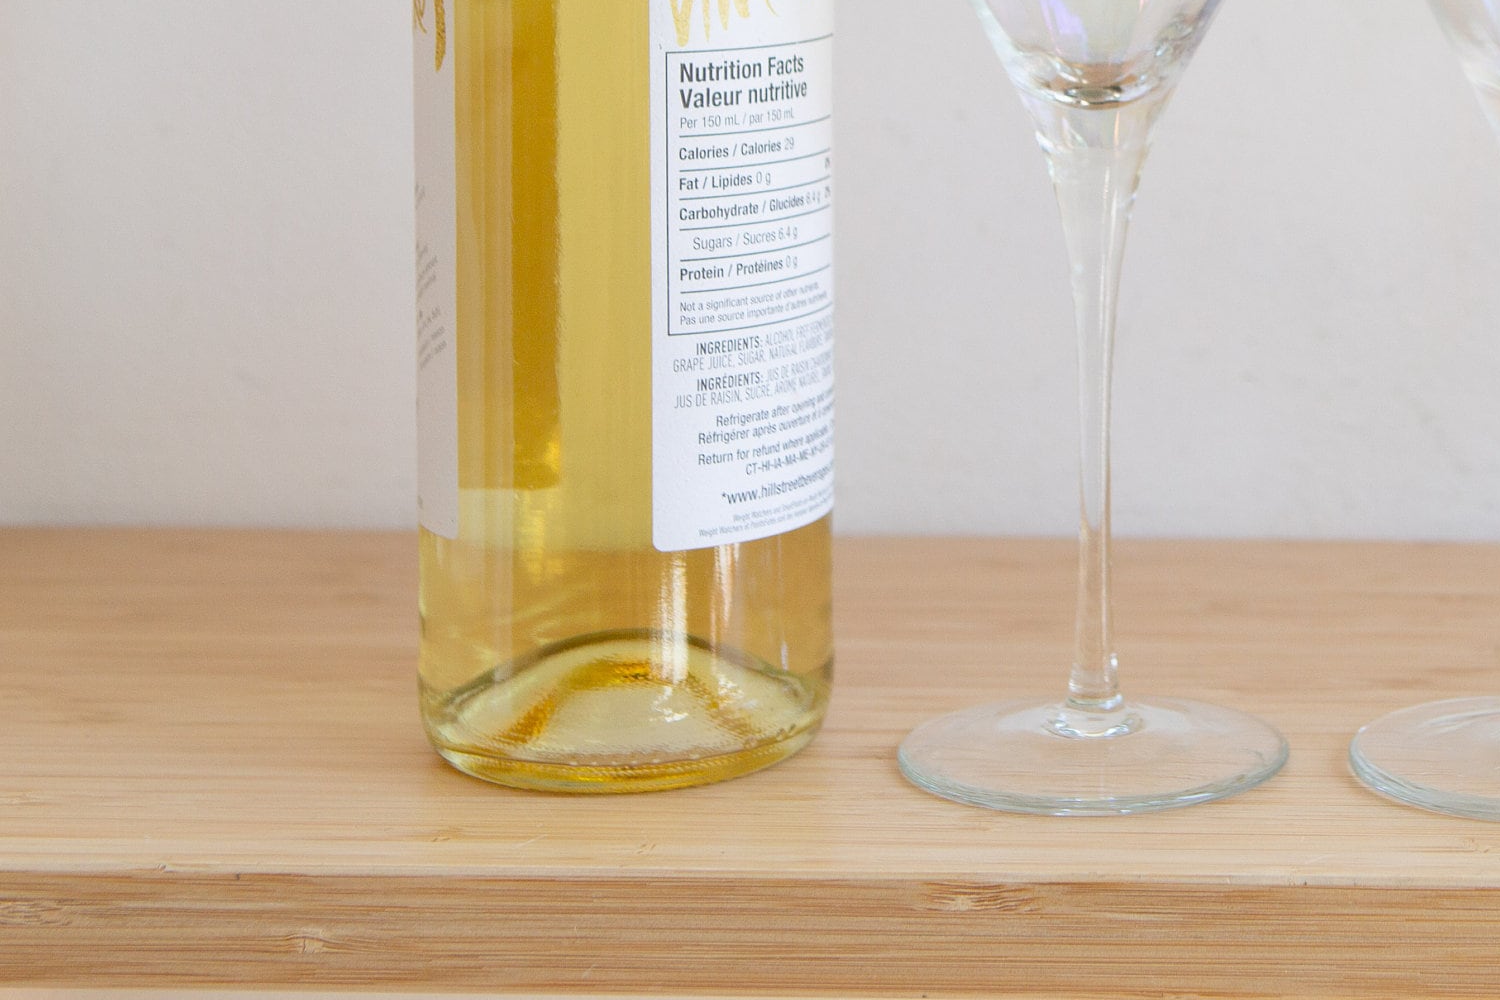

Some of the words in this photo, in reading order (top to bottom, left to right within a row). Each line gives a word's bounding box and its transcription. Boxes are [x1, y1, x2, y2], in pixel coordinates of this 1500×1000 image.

[680, 60, 762, 83] Nutrition
[768, 54, 804, 76] Facts
[679, 88, 742, 109] Valeur
[749, 80, 807, 105] nutritive
[680, 116, 697, 129] Per
[702, 114, 721, 128] 150
[725, 113, 740, 126] mL
[749, 112, 763, 125] par
[767, 109, 782, 121] 150
[784, 107, 795, 120] mL
[679, 145, 729, 161] Calories
[741, 139, 781, 156] Calories
[784, 136, 795, 151] 29
[679, 177, 699, 191] Fat
[712, 172, 753, 190] Lipides
[765, 171, 771, 185] g
[679, 202, 759, 221] Carbohydrate
[770, 195, 804, 212] Glucides
[693, 236, 732, 252] Sugars
[743, 229, 776, 246] Sucres
[778, 226, 791, 241] 6.4
[792, 226, 798, 240] g
[680, 267, 724, 282] Protein
[736, 257, 783, 276] Protéines
[792, 256, 798, 269] g
[680, 300, 696, 312] Not
[698, 303, 704, 311] a
[707, 295, 749, 312] significant
[750, 291, 775, 304] source
[680, 313, 696, 326] Pas
[699, 313, 715, 324] une
[717, 309, 745, 322] source
[747, 302, 784, 321] importante
[696, 336, 763, 355] INGREDIENTS:
[673, 356, 704, 372] GRAPE
[707, 353, 735, 369] JUICE,
[697, 371, 763, 391] INGRÉDIENTS:
[674, 394, 692, 409] JUS
[695, 393, 707, 407] DE
[710, 389, 743, 405] RAISIN,
[716, 408, 769, 427] Refrigerate
[771, 404, 789, 418] after
[698, 427, 749, 445] Réfrigérer
[752, 423, 776, 440] après
[698, 451, 733, 466] Return
[736, 449, 750, 461] for
[752, 442, 781, 457] refund
